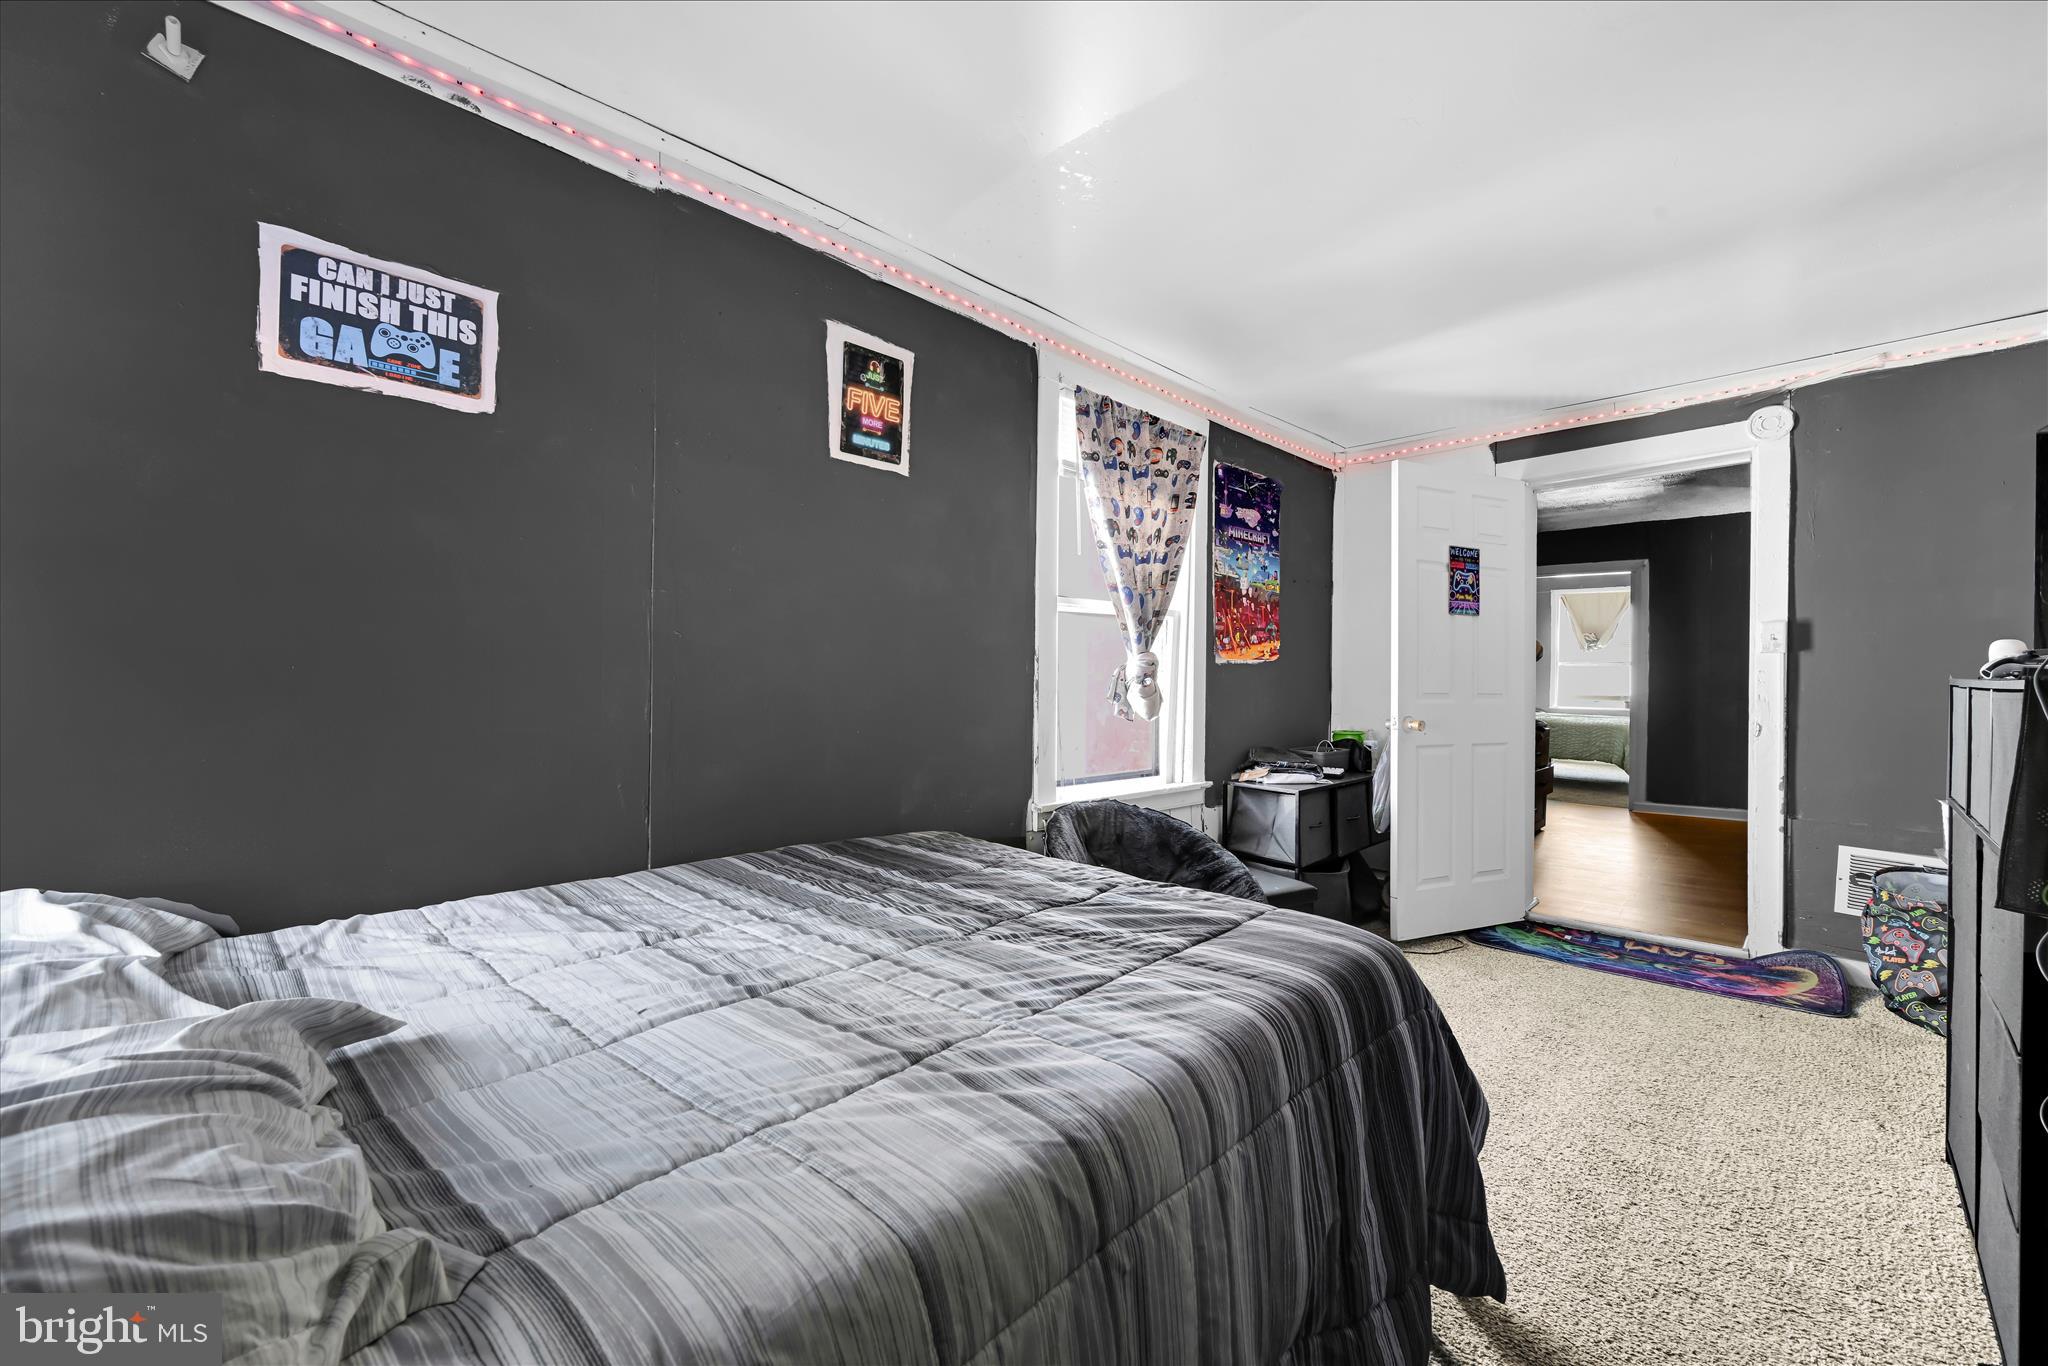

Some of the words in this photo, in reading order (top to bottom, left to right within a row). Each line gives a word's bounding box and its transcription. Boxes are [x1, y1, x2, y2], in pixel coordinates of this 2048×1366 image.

[318, 257, 374, 291] CAN
[380, 274, 390, 296] I
[395, 279, 456, 313] JUST
[290, 273, 401, 326] FINISH
[409, 305, 477, 345] THIS
[299, 316, 461, 389] GAE
[846, 387, 901, 423] FIVE
[862, 417, 883, 428] MORE
[1228, 526, 1270, 545] MINECRAFT
[1450, 547, 1478, 557] WELCOME
